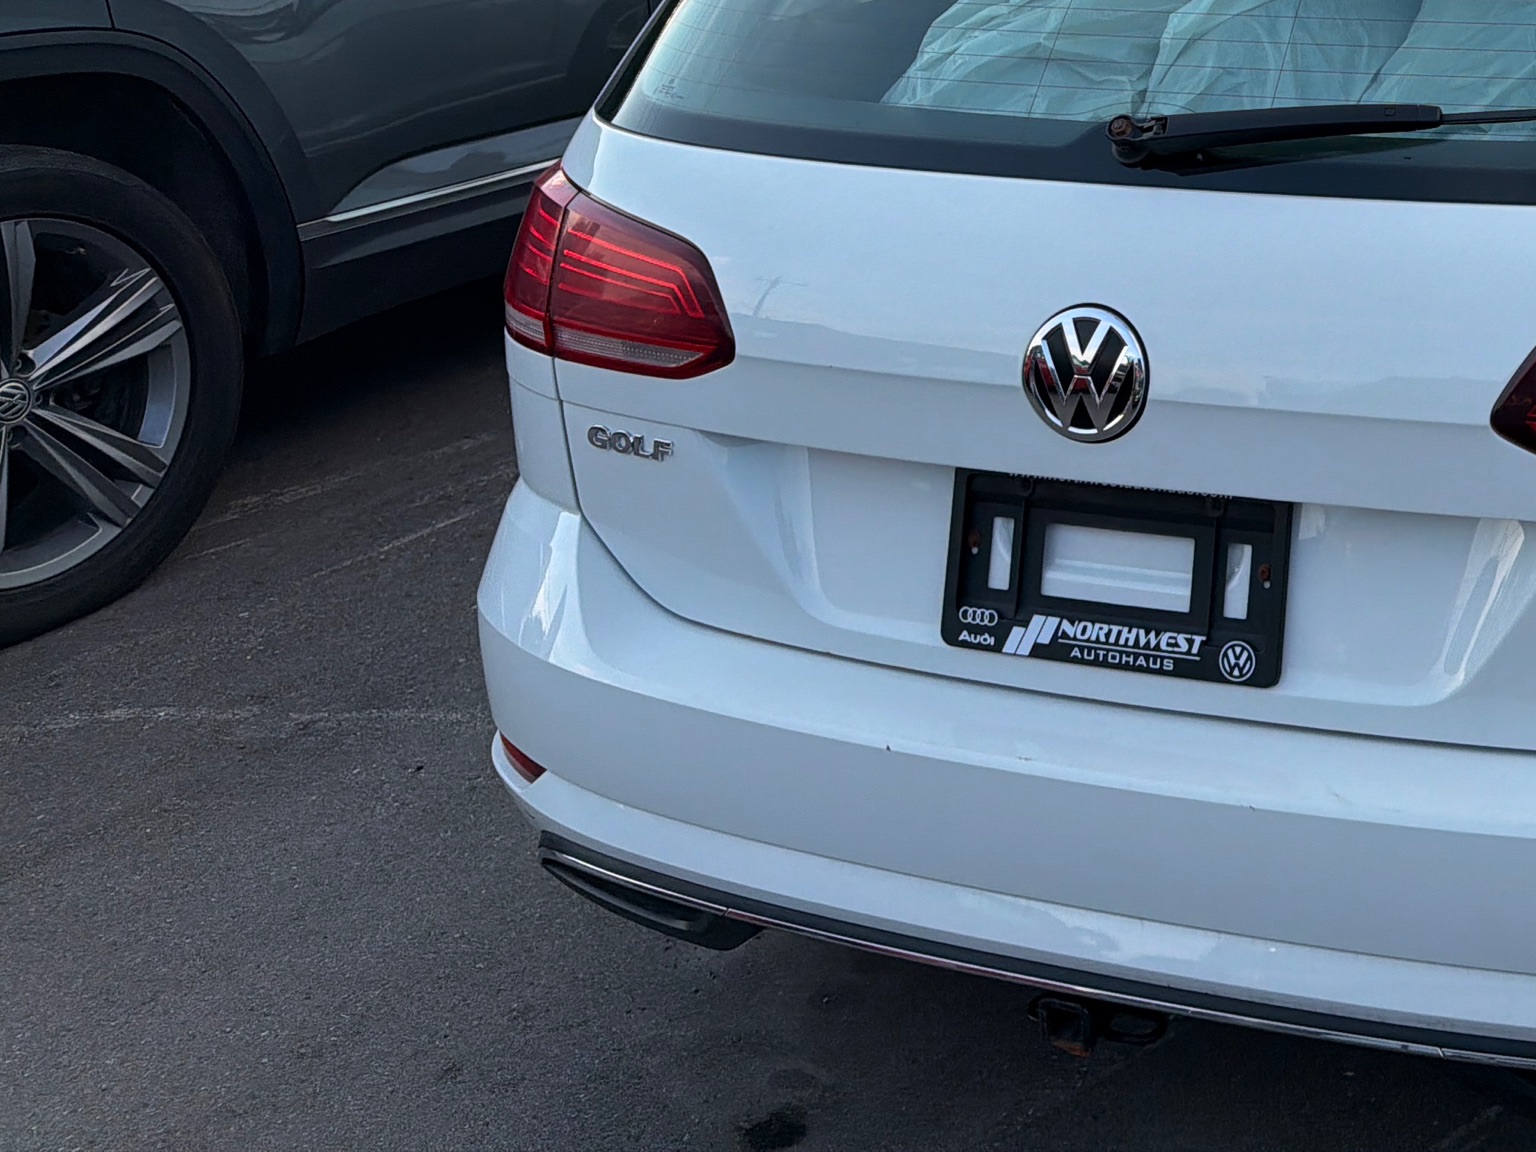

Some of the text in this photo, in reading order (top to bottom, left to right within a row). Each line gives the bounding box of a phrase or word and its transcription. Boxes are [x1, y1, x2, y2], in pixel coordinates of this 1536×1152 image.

[587, 424, 674, 463] GOLF
[1057, 619, 1207, 655] NORTHWEST
[1069, 647, 1175, 672] AUTOHAUS
